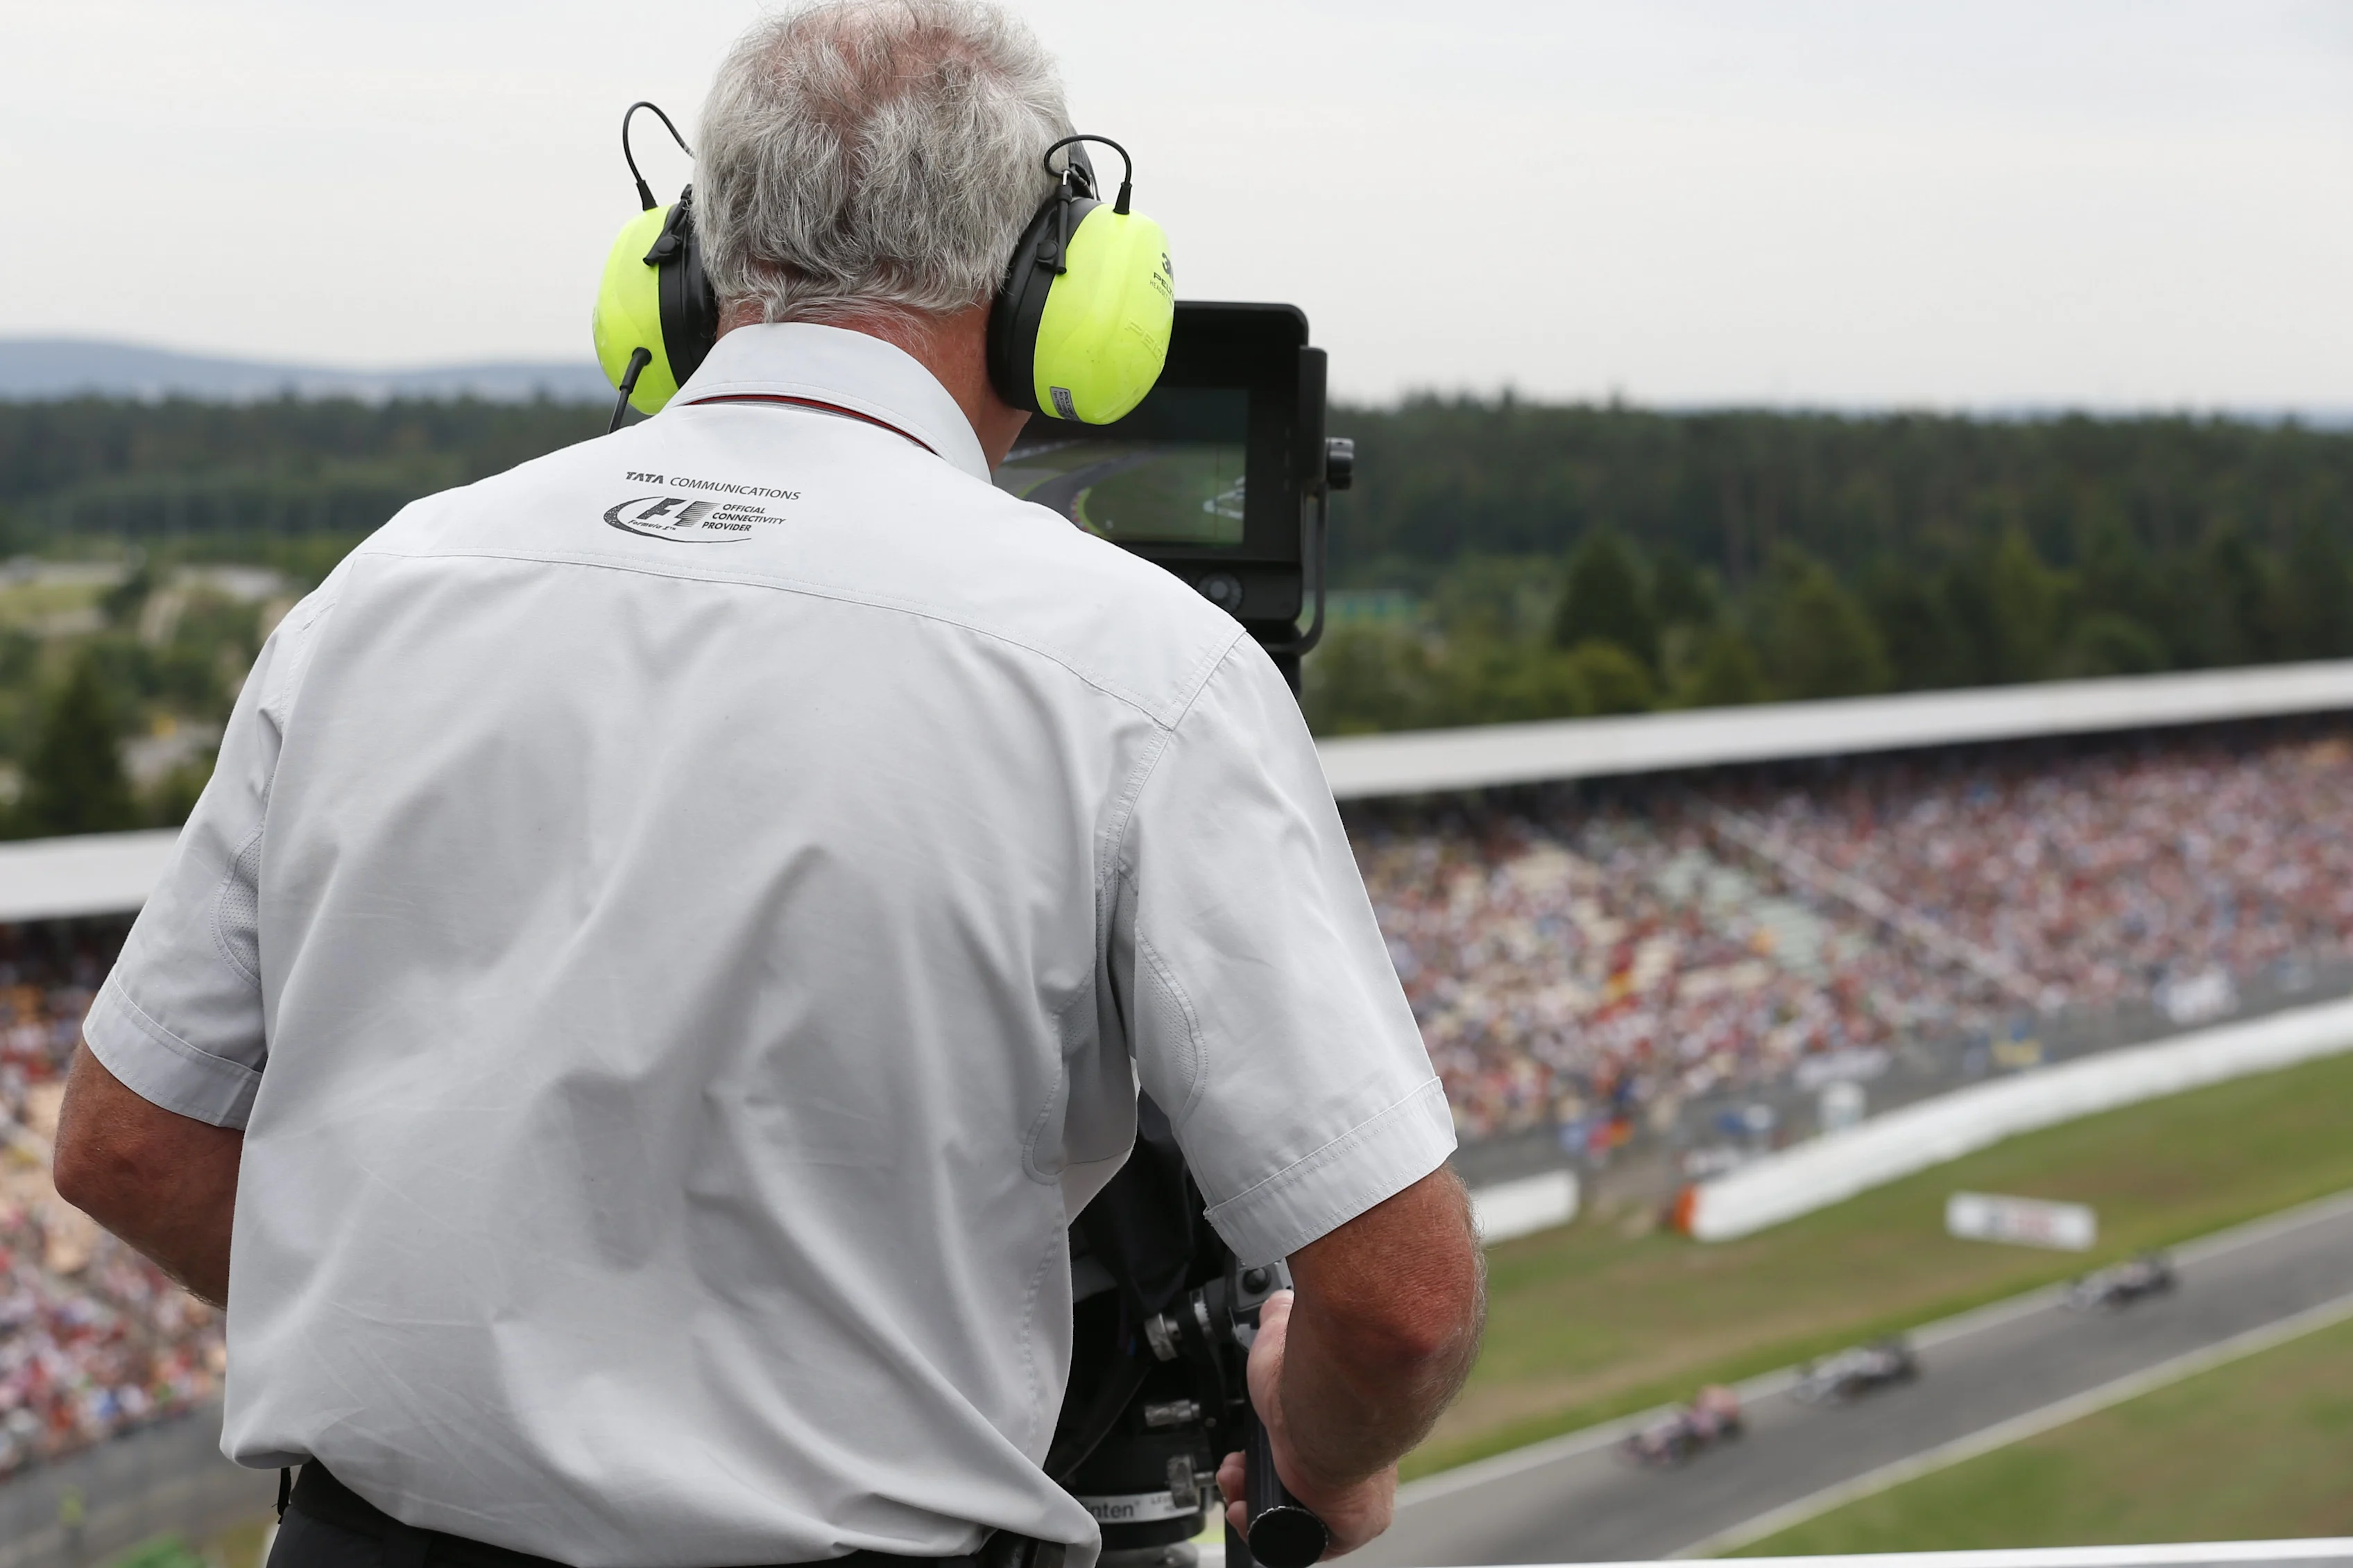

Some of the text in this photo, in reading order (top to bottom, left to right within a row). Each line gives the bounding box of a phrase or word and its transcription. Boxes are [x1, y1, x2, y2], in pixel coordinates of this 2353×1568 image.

[625, 472, 801, 500] TATA COMMUNICATIONS
[722, 503, 767, 514] OFFICIAL
[627, 519, 662, 529] Formula
[712, 512, 787, 525] CONNECTIVITY
[701, 522, 752, 532] PROVIDER
[1084, 1501, 1135, 1519] nten
